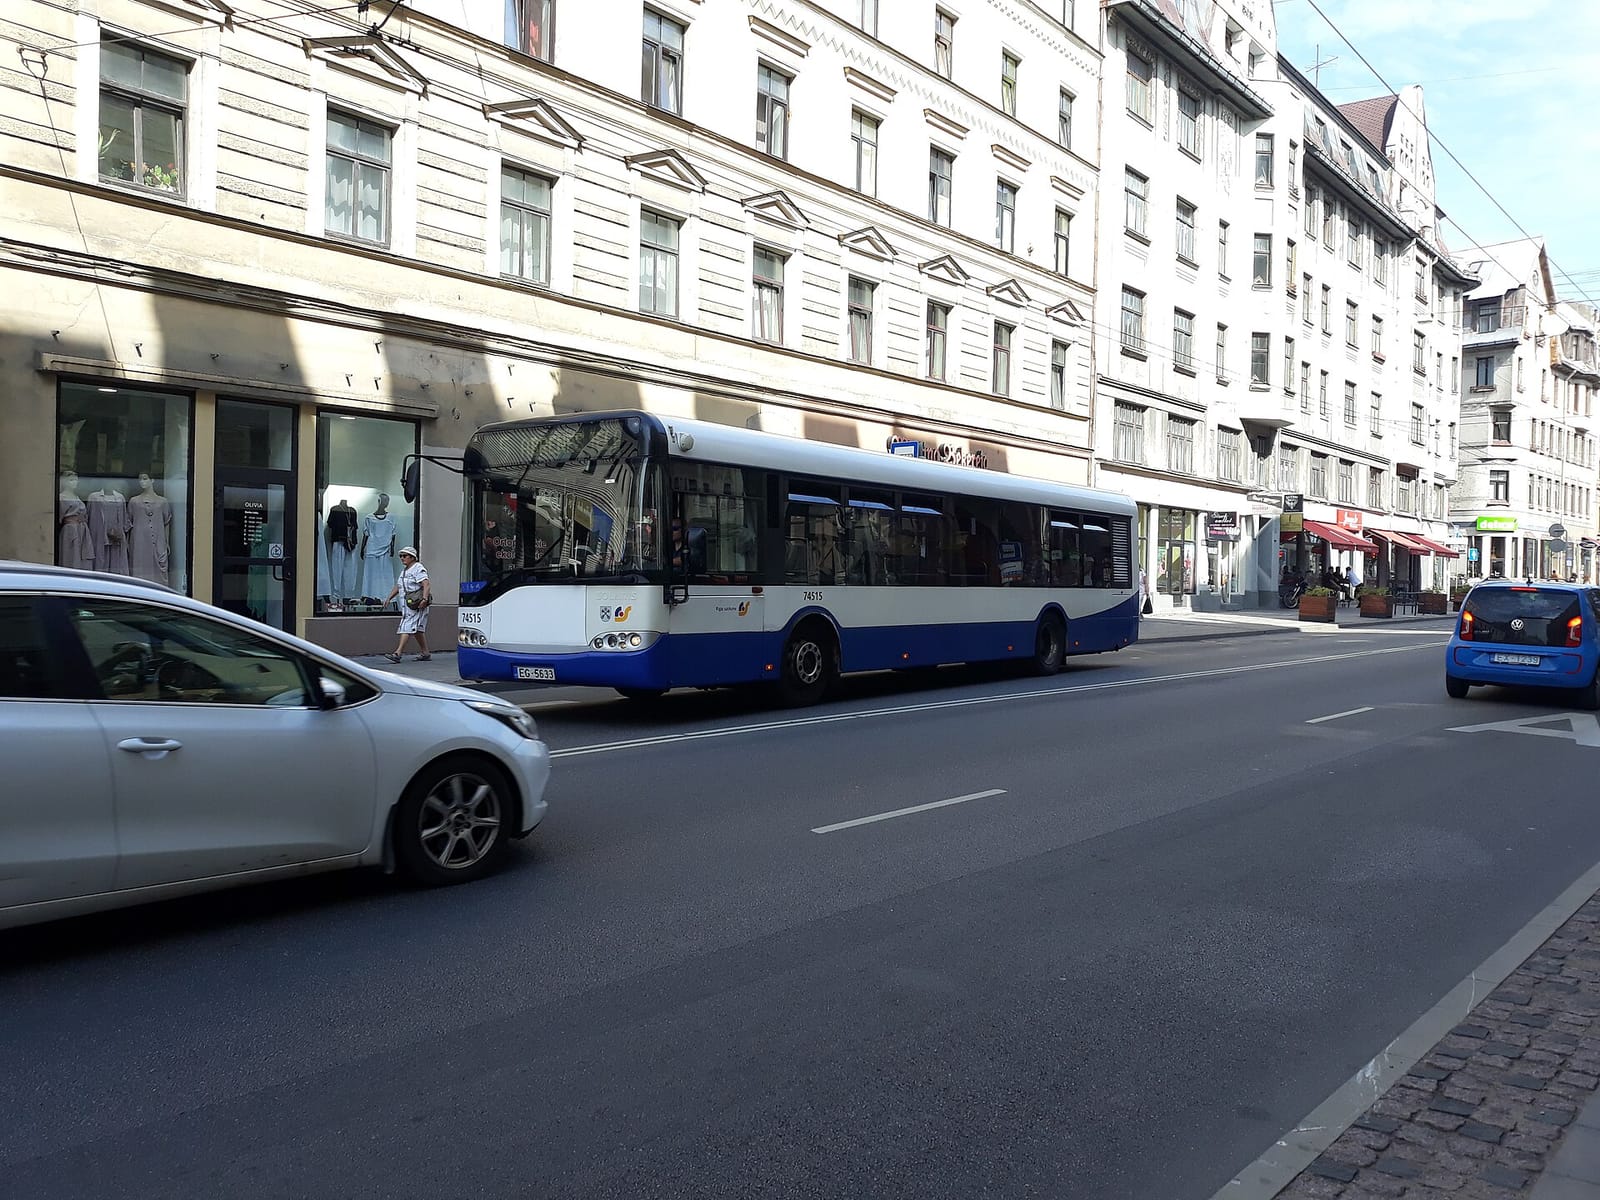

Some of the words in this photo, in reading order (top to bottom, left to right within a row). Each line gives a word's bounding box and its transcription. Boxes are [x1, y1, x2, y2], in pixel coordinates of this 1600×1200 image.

[802, 591, 823, 601] 74515
[462, 612, 482, 624] 74515
[519, 668, 554, 679] EG-5633
